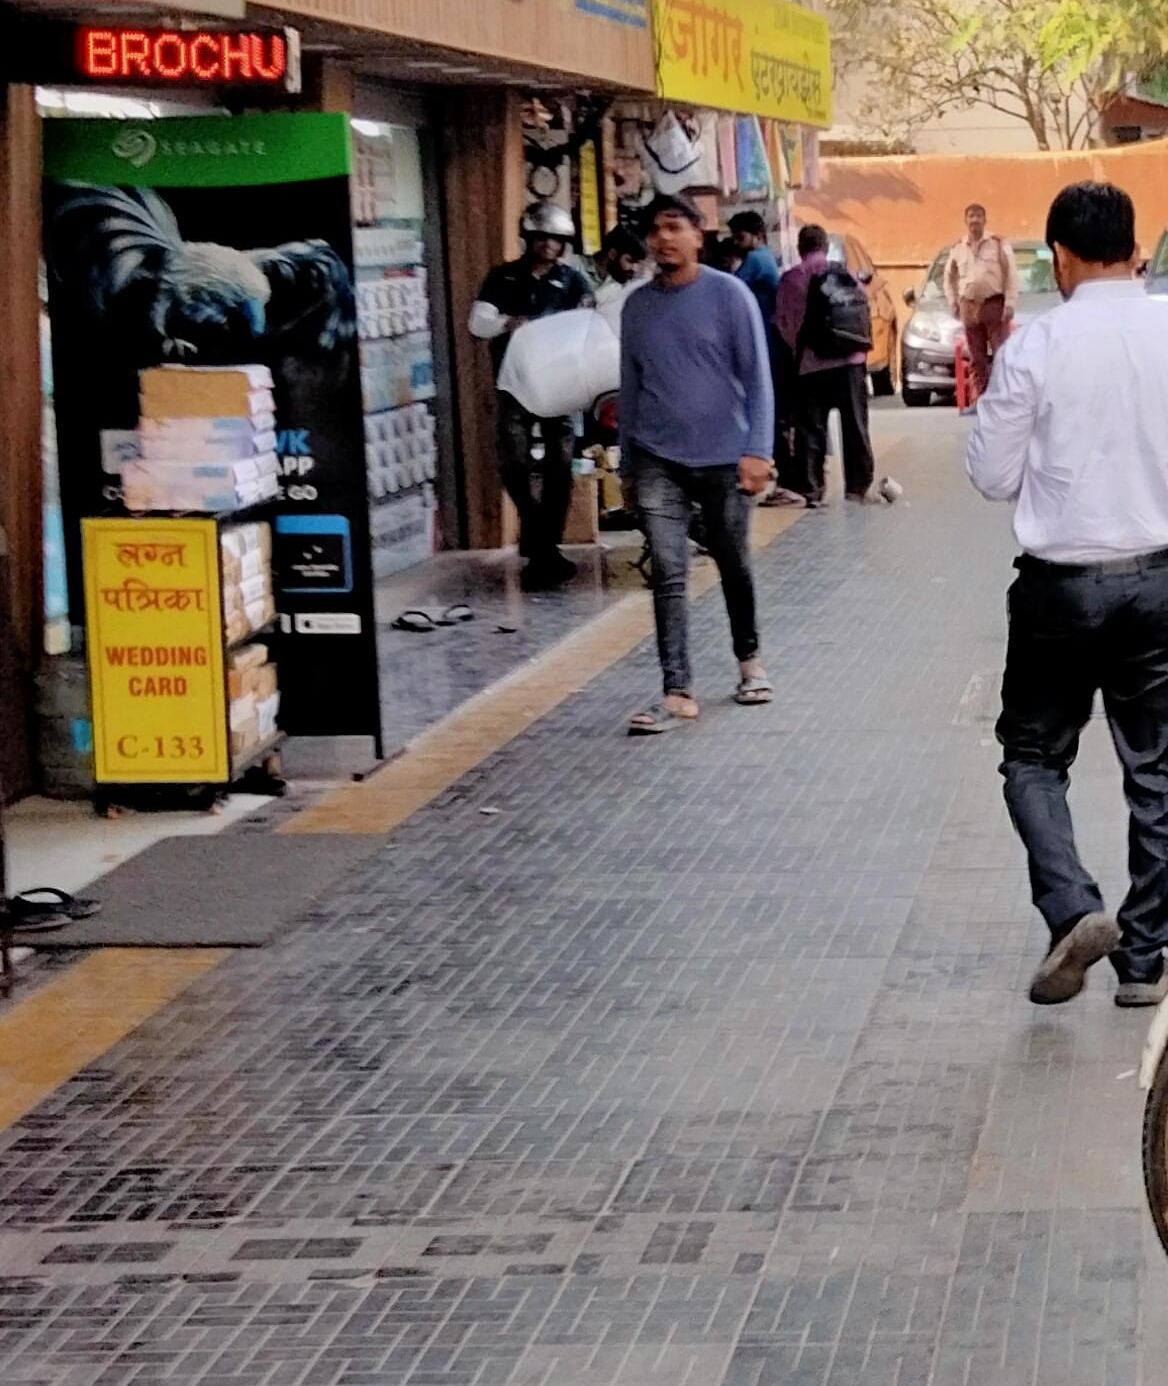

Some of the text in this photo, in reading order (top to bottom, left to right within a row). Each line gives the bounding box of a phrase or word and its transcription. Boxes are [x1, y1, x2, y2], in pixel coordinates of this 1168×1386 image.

[88, 31, 284, 79] BROCHU
[114, 542, 187, 568] लग्न
[101, 578, 205, 612] पत्रिका
[105, 646, 207, 666] WEDDING
[128, 677, 187, 697] CARD
[117, 734, 204, 760] C-133
